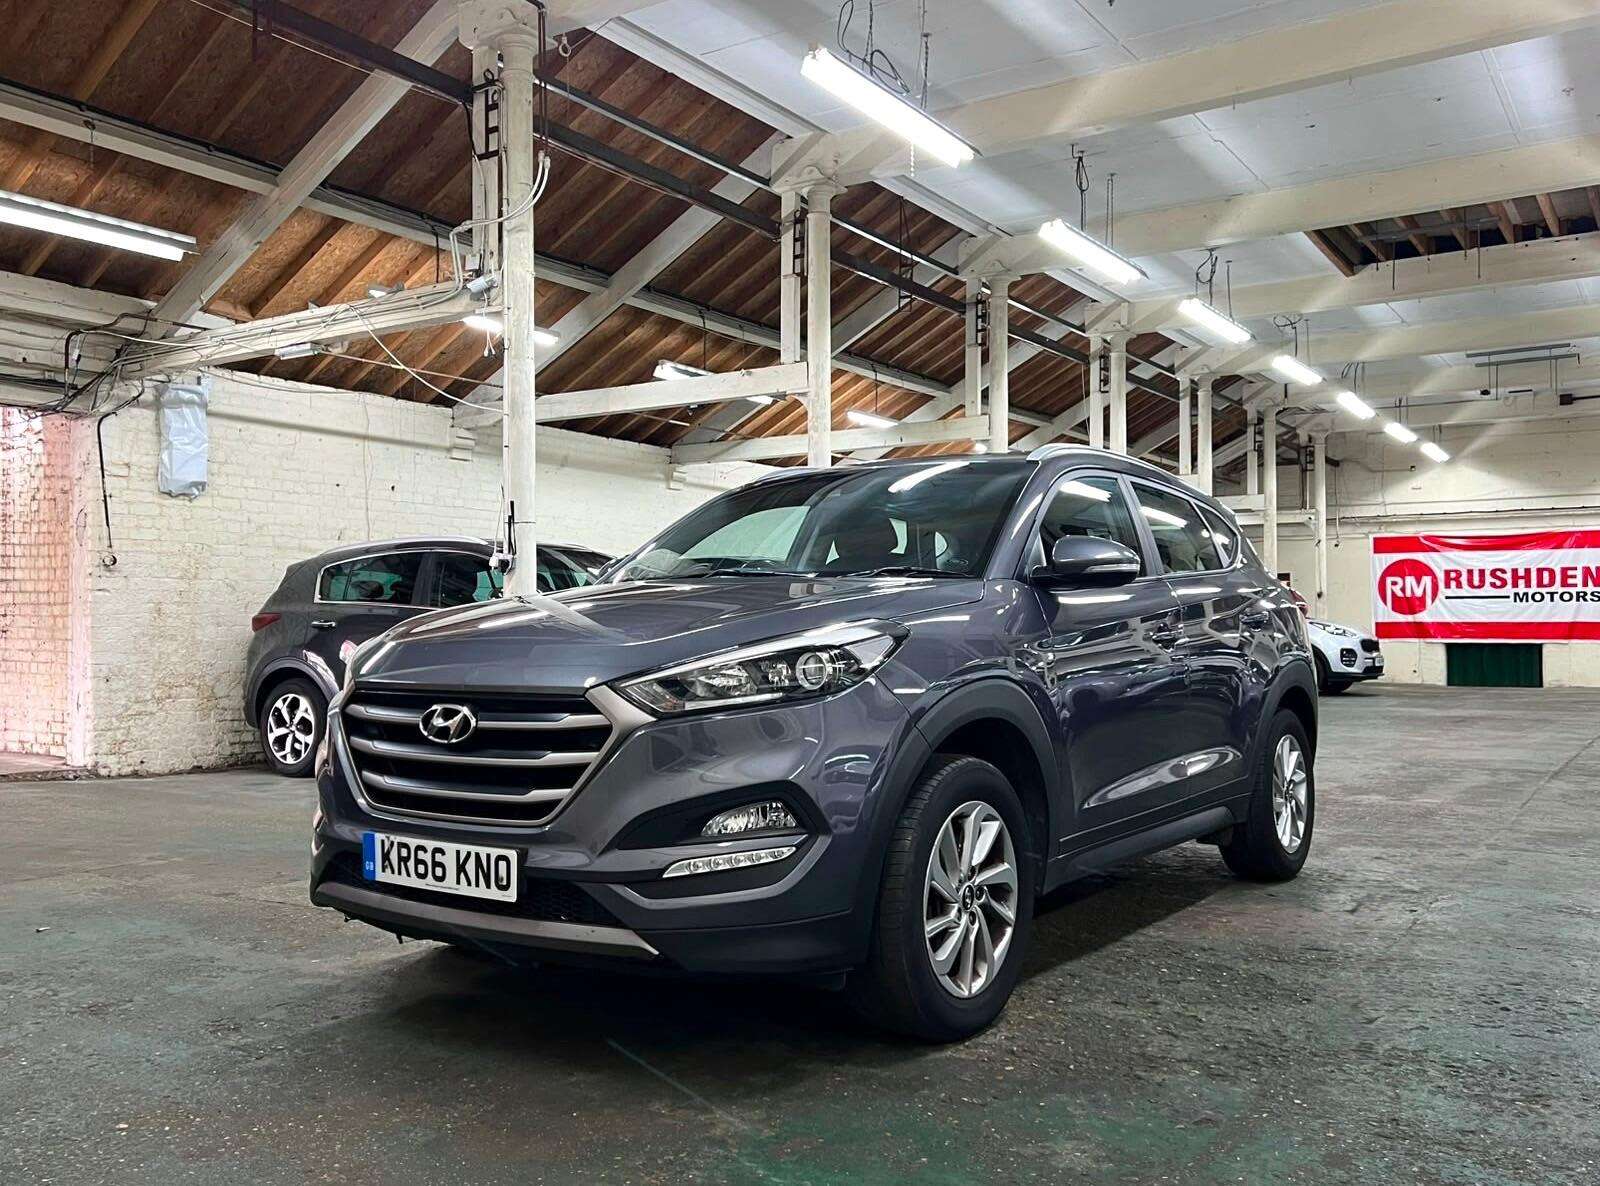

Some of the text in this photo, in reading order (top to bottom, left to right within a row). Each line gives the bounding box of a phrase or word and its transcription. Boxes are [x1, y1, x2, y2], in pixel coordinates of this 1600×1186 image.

[1444, 566, 1600, 589] RUSHDEN
[1385, 575, 1433, 610] RM
[1513, 591, 1600, 603] MOTORS
[381, 839, 511, 892] KR66 KNO
